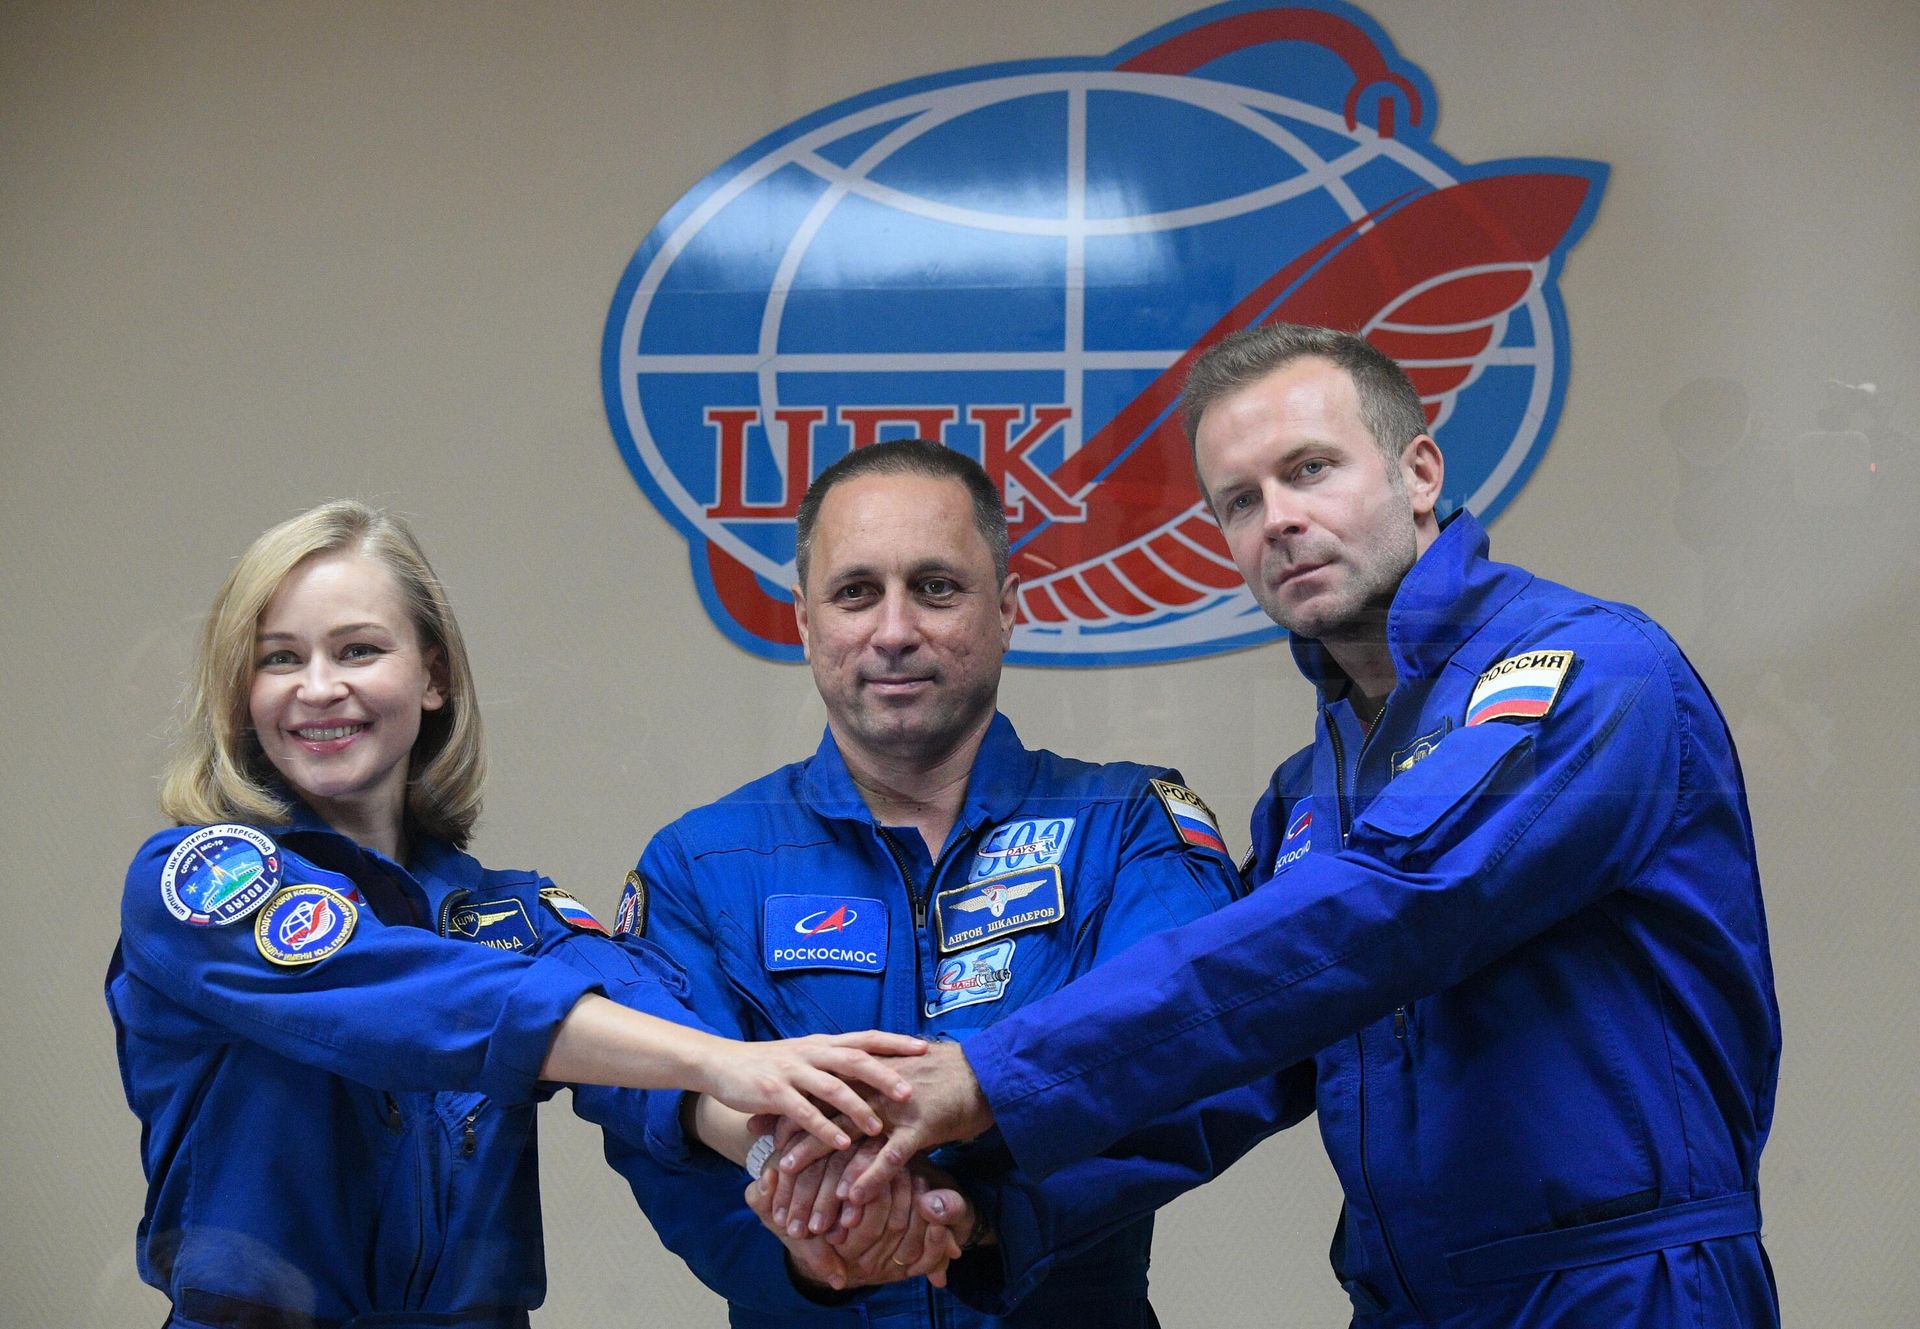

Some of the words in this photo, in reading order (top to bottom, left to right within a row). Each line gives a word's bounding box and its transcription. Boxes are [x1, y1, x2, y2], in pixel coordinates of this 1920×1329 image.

[1478, 655, 1564, 689] РОССИЯ
[169, 830, 214, 870] ШКАПЛЕРОВ
[227, 828, 271, 853] ПЕРЕСИЛЬД
[181, 853, 197, 874] СОЮЗ
[1006, 844, 1036, 856] DAYS
[165, 881, 186, 916] ШИПЕНКО
[225, 883, 263, 914] ВЫЗОВ
[947, 926, 983, 945] АНТОН
[987, 907, 1055, 933] ШКАПЛЕРОВ
[774, 948, 877, 964] РОСКОСМОС
